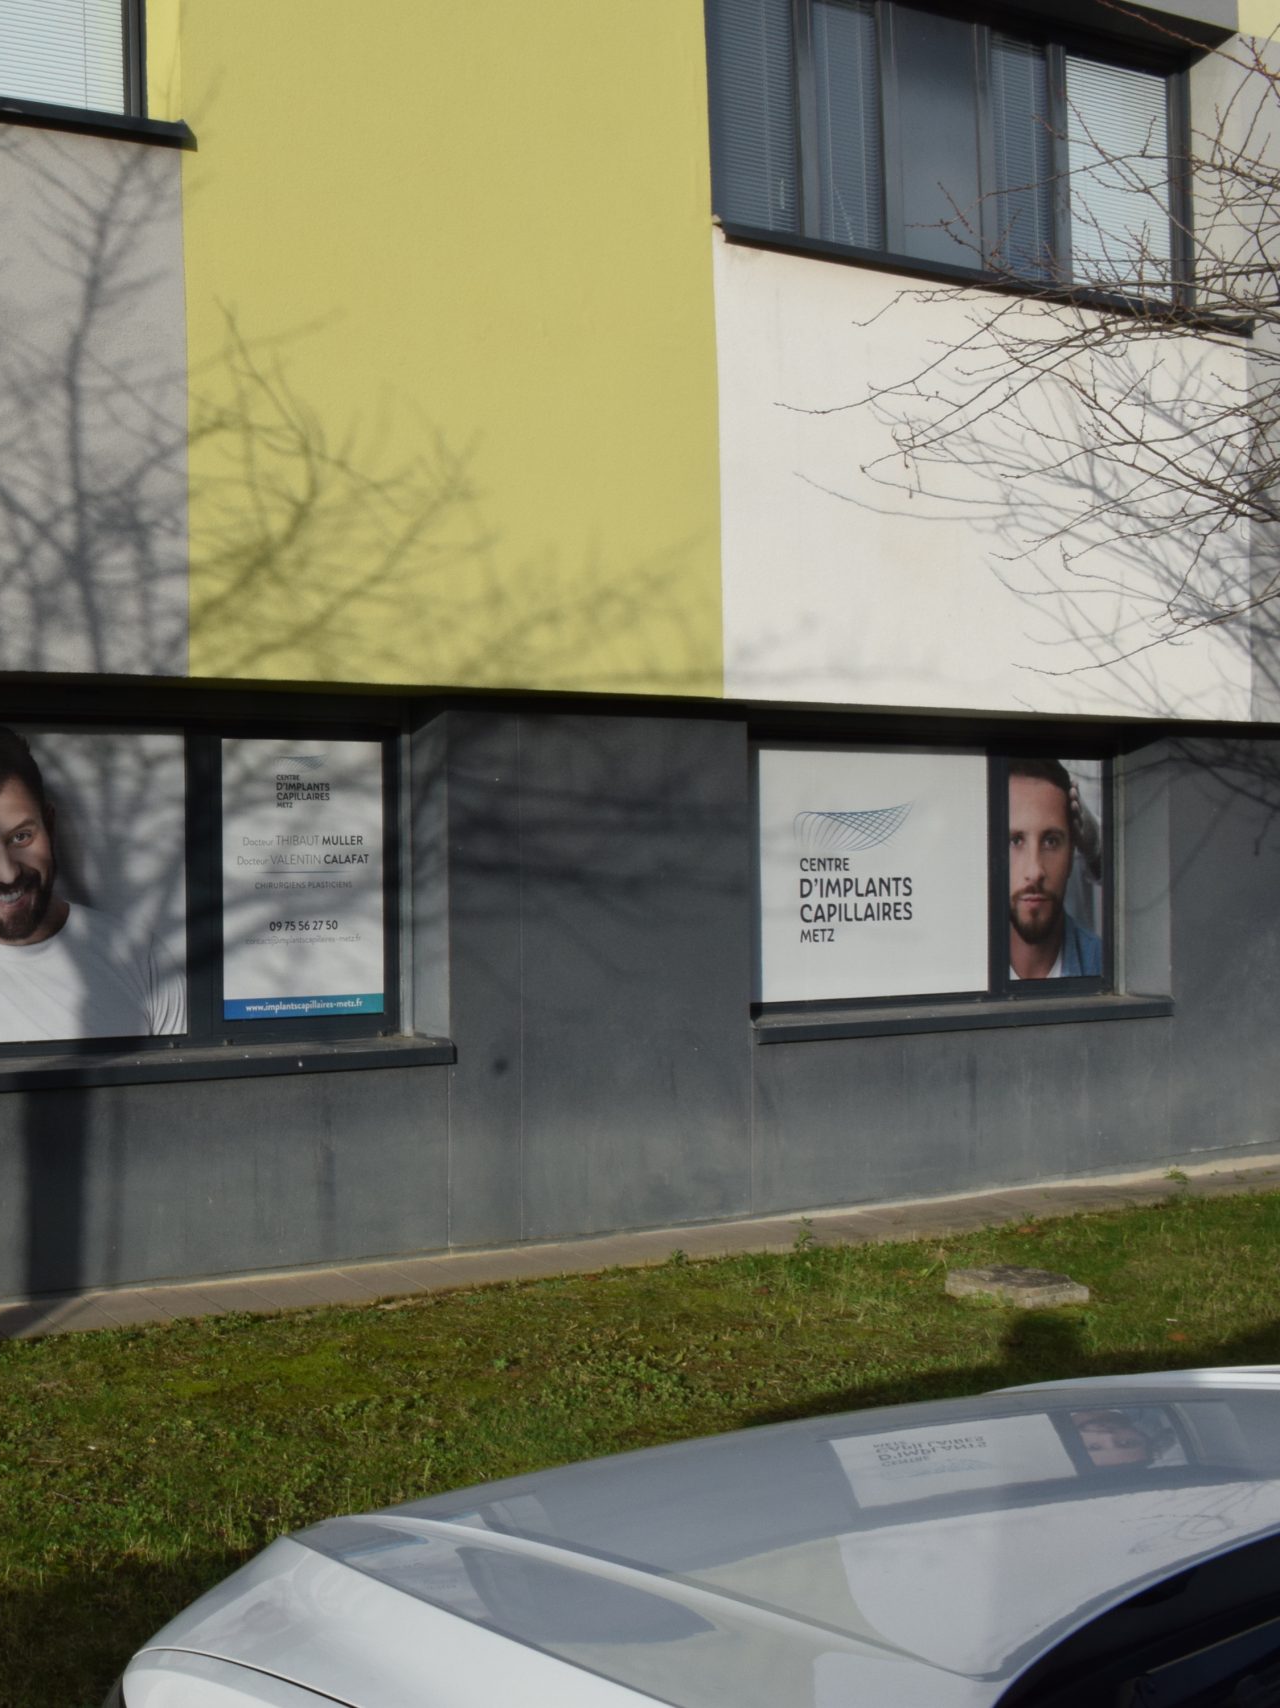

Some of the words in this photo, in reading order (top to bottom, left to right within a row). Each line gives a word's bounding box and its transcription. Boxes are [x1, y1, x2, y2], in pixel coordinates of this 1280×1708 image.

[276, 792, 330, 801] CAPILLAIRES
[242, 837, 273, 846] Docteur
[276, 835, 319, 846] THIBAUT
[322, 835, 363, 846] MULLER
[237, 856, 268, 866] Docteur
[270, 854, 321, 865] VALENTIN
[324, 853, 369, 864] CALAFAT
[800, 857, 850, 872] CENTRE
[255, 881, 306, 889] CHIRURGIENS
[307, 880, 352, 889] PLASTICIENS
[800, 877, 913, 898] D'IMPLANTS
[800, 902, 913, 923] CAPILLAIRES
[270, 921, 282, 931] 09
[284, 921, 296, 931] 75
[298, 921, 310, 931] 56
[312, 920, 323, 930] 27
[326, 920, 338, 930] 50
[800, 928, 835, 943] METZ
[245, 998, 363, 1013] www.implantscapillaires-metz.fr
